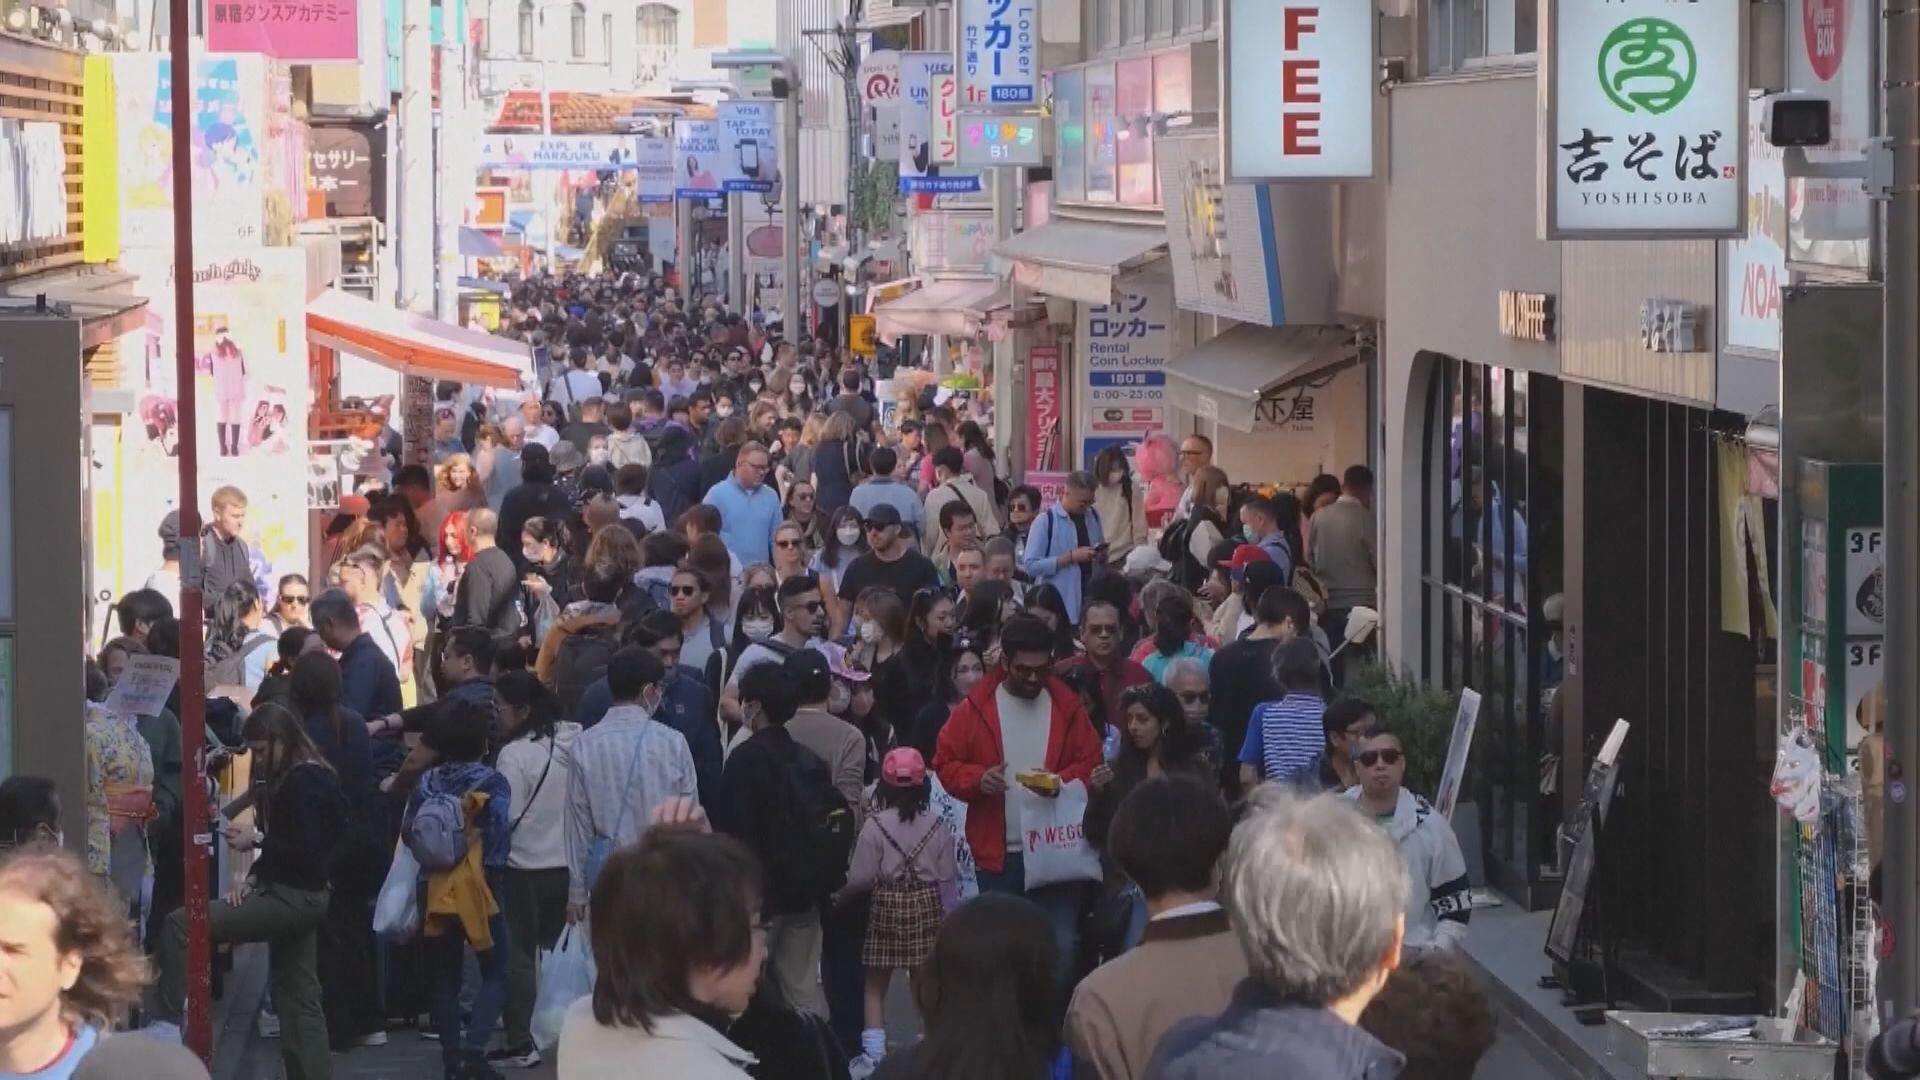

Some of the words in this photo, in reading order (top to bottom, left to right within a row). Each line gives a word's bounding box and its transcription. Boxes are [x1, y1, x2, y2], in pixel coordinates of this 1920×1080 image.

[214, 4, 350, 23] 原宿ダンスアカデミー
[966, 25, 978, 77] 竹下通り
[1018, 8, 1033, 76] Locker
[1816, 27, 1835, 56] BOX
[966, 85, 987, 103] 1F
[736, 106, 760, 115] VISA
[726, 120, 744, 129] TAP
[752, 128, 772, 136] PAY
[307, 149, 369, 170] セサリー
[1560, 127, 1722, 184] 吉そば
[1581, 191, 1708, 206] YOSHISOBA
[1740, 263, 1780, 319] NOA
[1089, 318, 1166, 338] ロッカー
[1090, 342, 1130, 353] Rental
[1090, 356, 1119, 366] Coin
[1122, 355, 1165, 367] Locker
